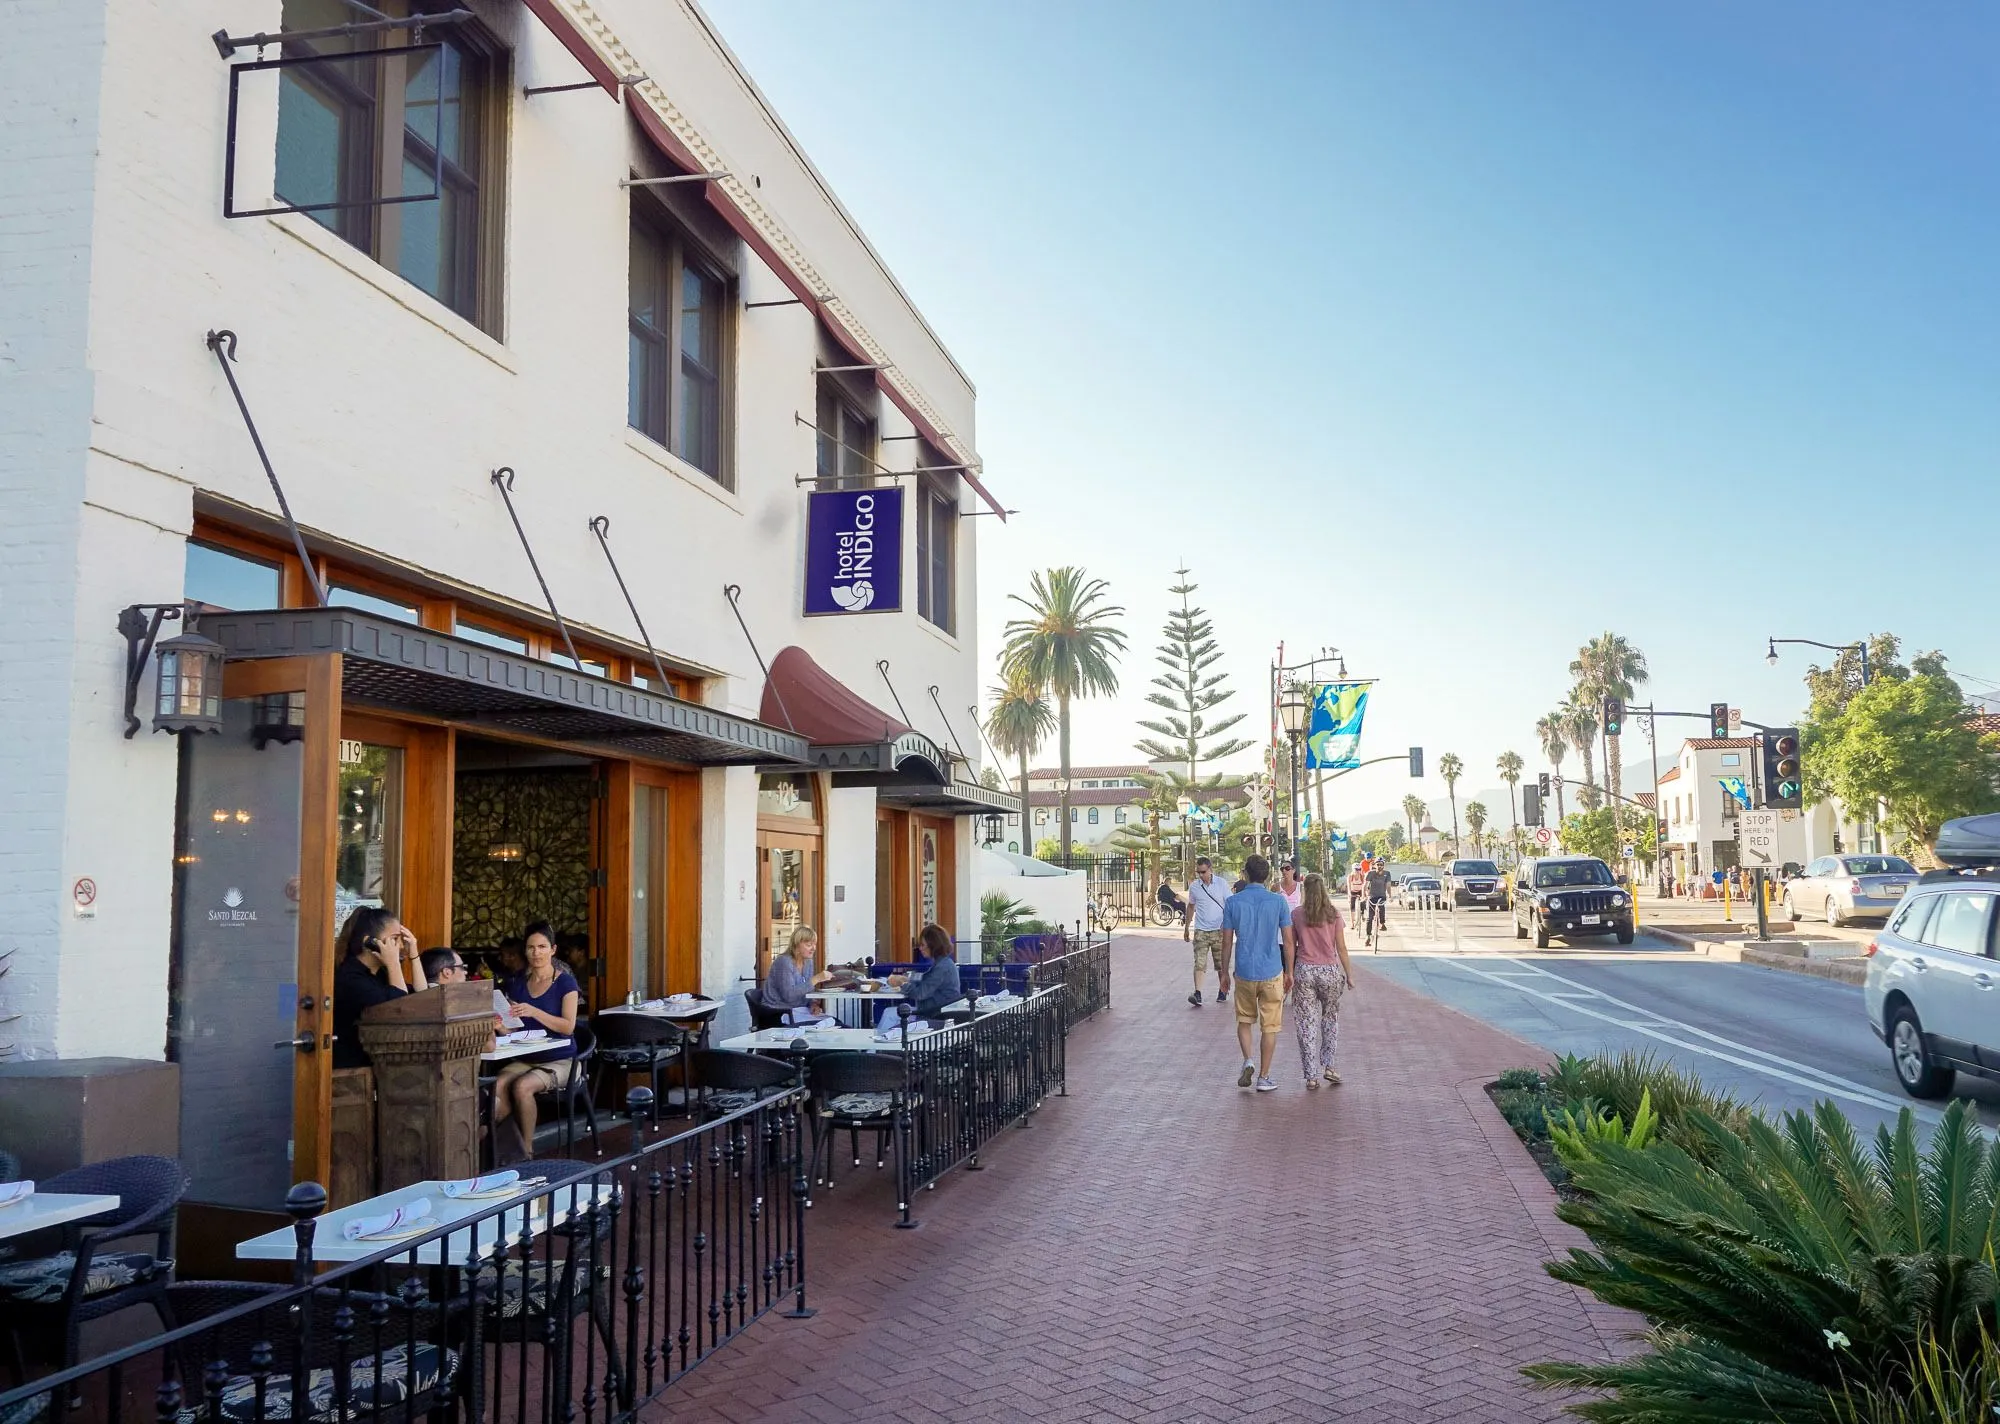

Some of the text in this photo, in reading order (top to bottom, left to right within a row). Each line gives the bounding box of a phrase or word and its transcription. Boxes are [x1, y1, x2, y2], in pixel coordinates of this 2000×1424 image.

[853, 494, 875, 578] INDIGO
[834, 531, 854, 579] hotel
[339, 740, 361, 762] 119
[1746, 815, 1772, 825] STOP
[1750, 836, 1770, 846] RED
[208, 909, 258, 921] SANTO MEZCAL
